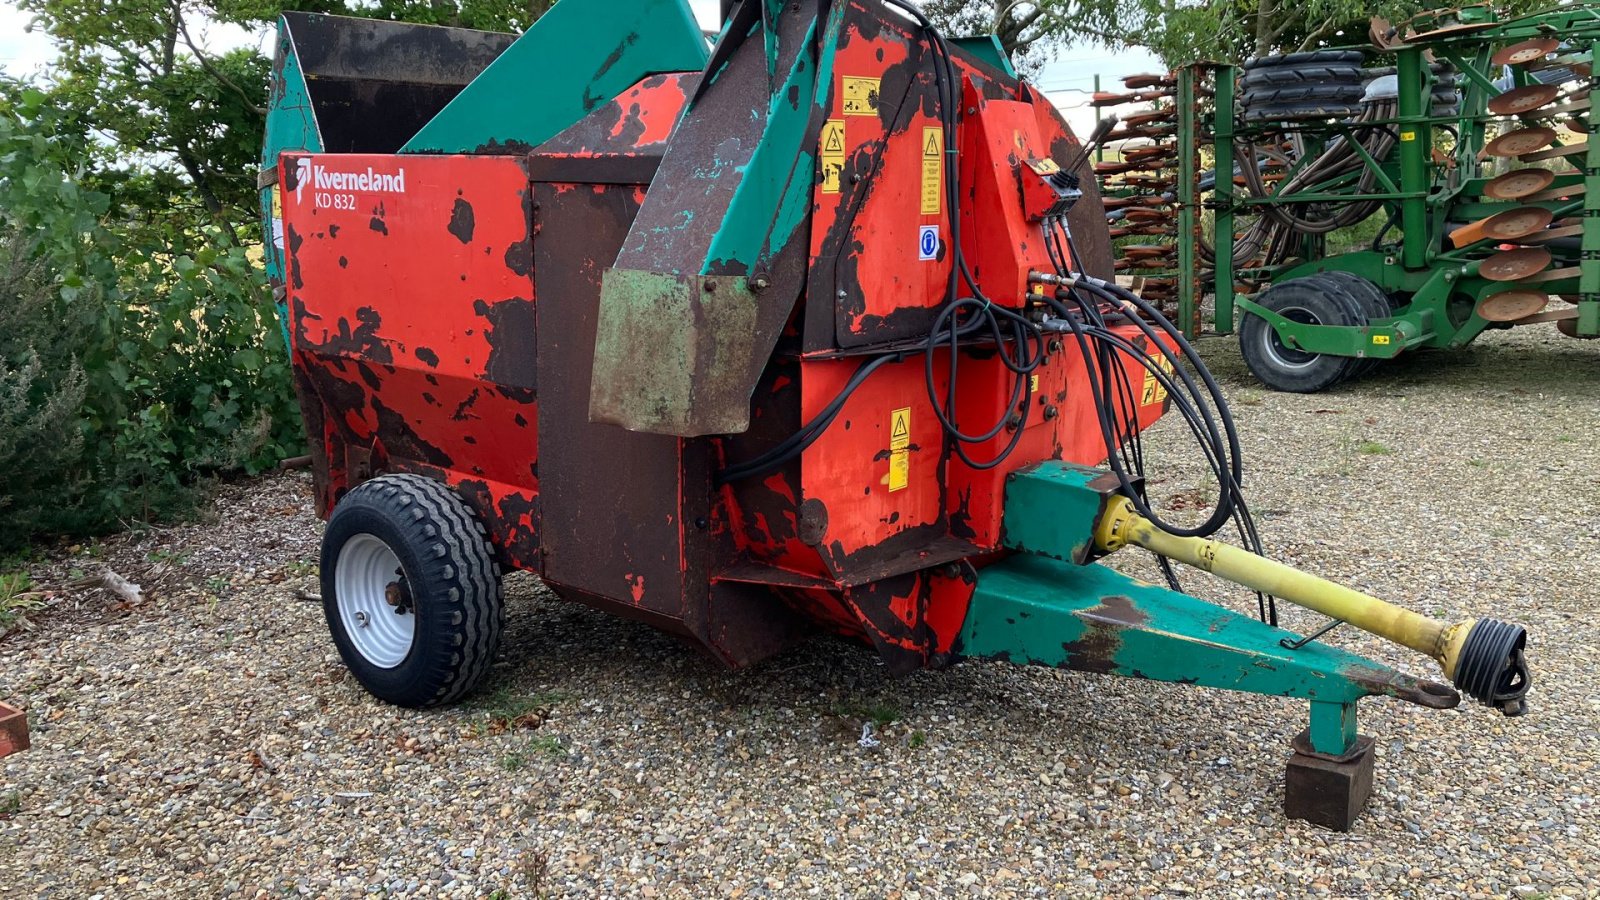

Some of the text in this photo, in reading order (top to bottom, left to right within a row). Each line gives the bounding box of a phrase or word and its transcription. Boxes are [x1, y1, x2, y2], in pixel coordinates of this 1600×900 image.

[314, 165, 405, 193] Kverneland
[315, 192, 356, 210] KD 832
